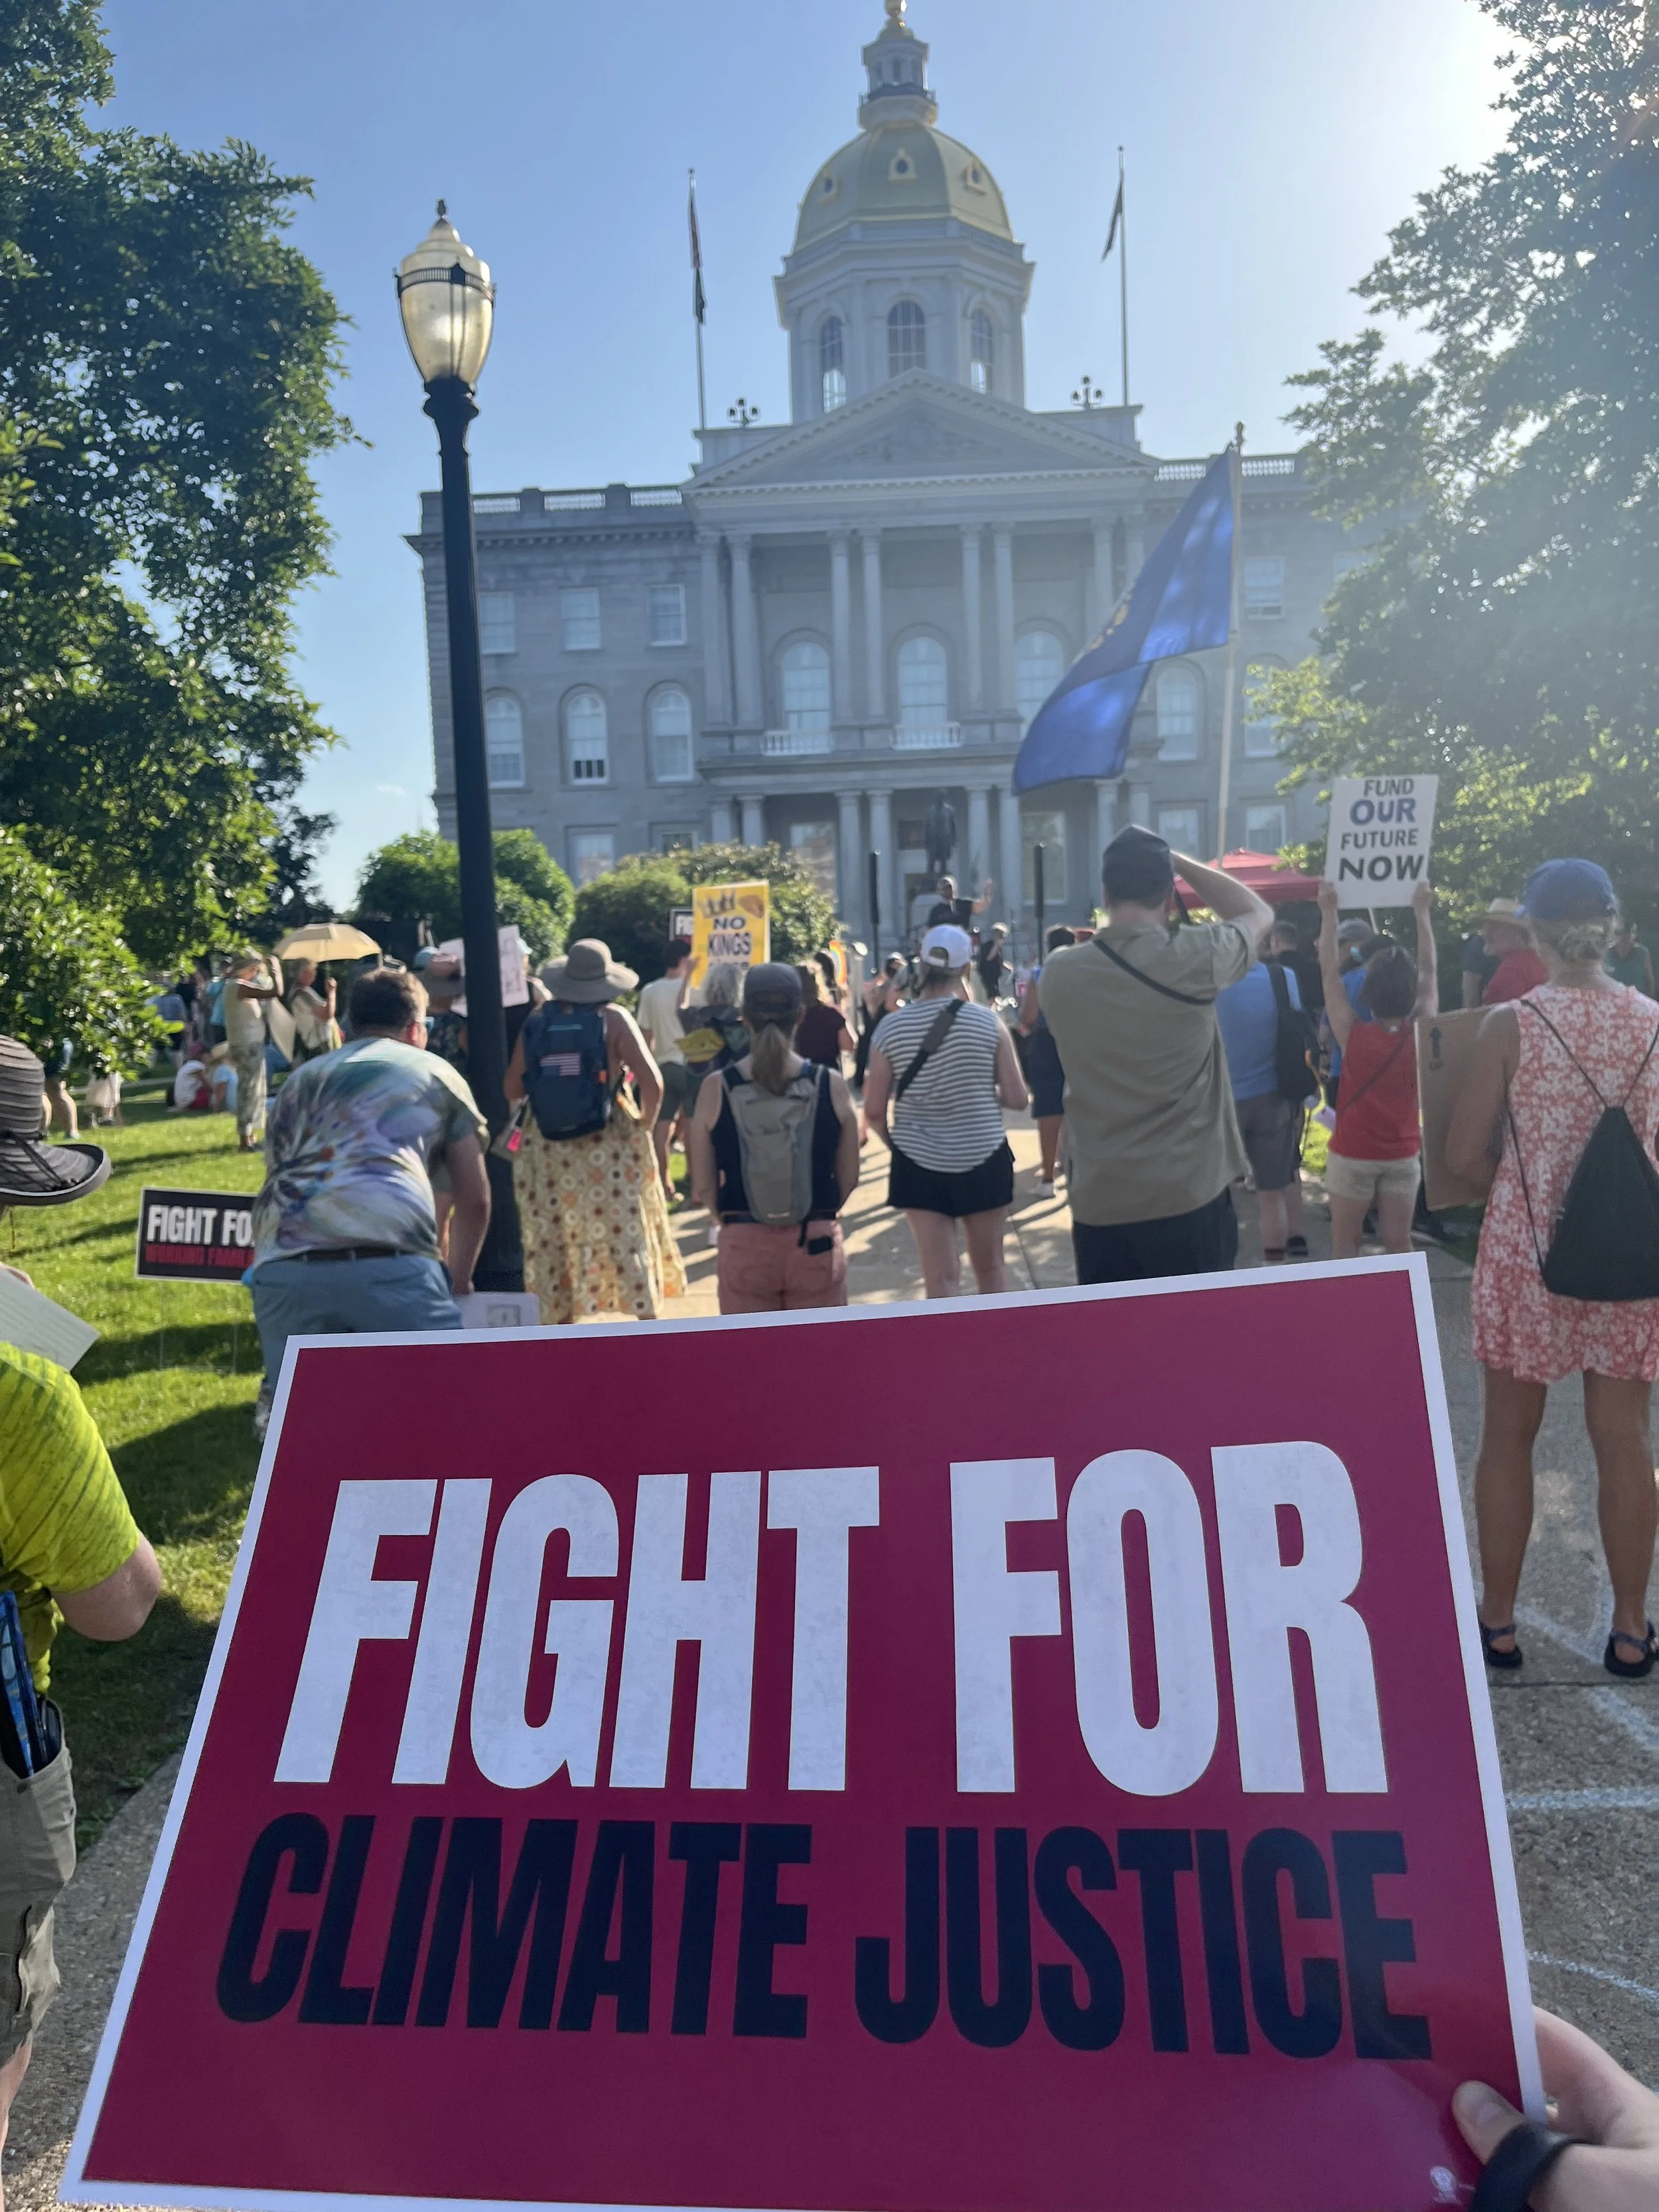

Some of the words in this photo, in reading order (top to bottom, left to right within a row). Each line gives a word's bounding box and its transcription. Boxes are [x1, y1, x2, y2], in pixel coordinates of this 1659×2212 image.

[1364, 778, 1414, 797] FUND
[1349, 798, 1415, 826] OUR
[1340, 829, 1419, 851] FUTURE
[1338, 855, 1423, 881] NOW
[713, 917, 746, 930] NO
[709, 932, 751, 956] KINGS
[147, 1205, 218, 1245] FIGHT
[222, 1209, 254, 1248] FO
[274, 1465, 880, 1791] FIGHT
[950, 1440, 1388, 1797] FOR
[216, 1812, 813, 2039] CLIMATE
[855, 1826, 1433, 2061] JUSTICE
